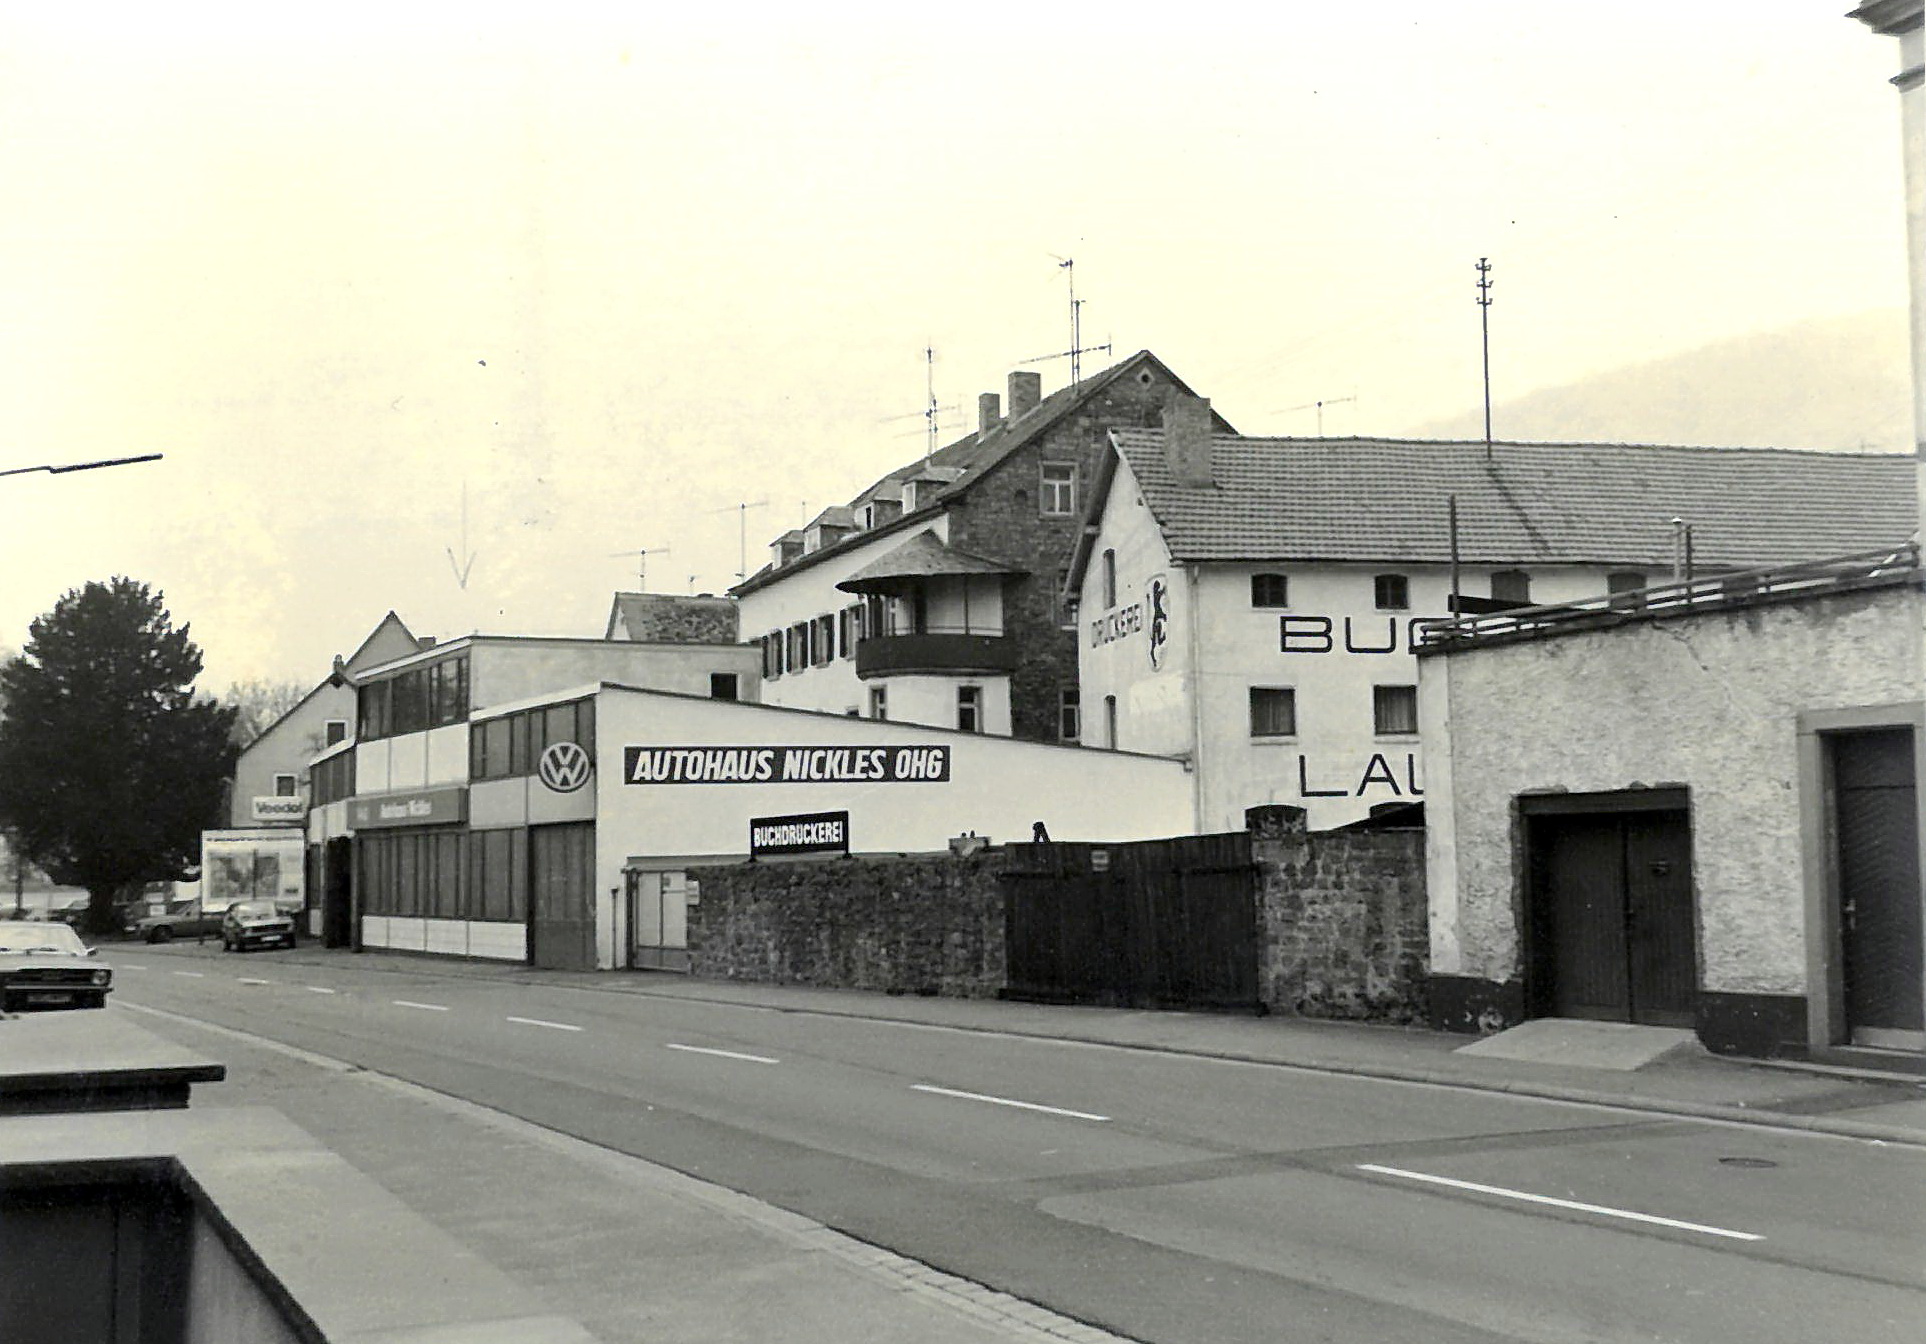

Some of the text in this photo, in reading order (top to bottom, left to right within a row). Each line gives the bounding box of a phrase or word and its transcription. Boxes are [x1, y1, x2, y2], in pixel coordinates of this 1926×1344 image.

[632, 747, 944, 781] AUTOHAUS NICKLES OHG
[753, 819, 842, 848] BUCHDRUCKEREI
